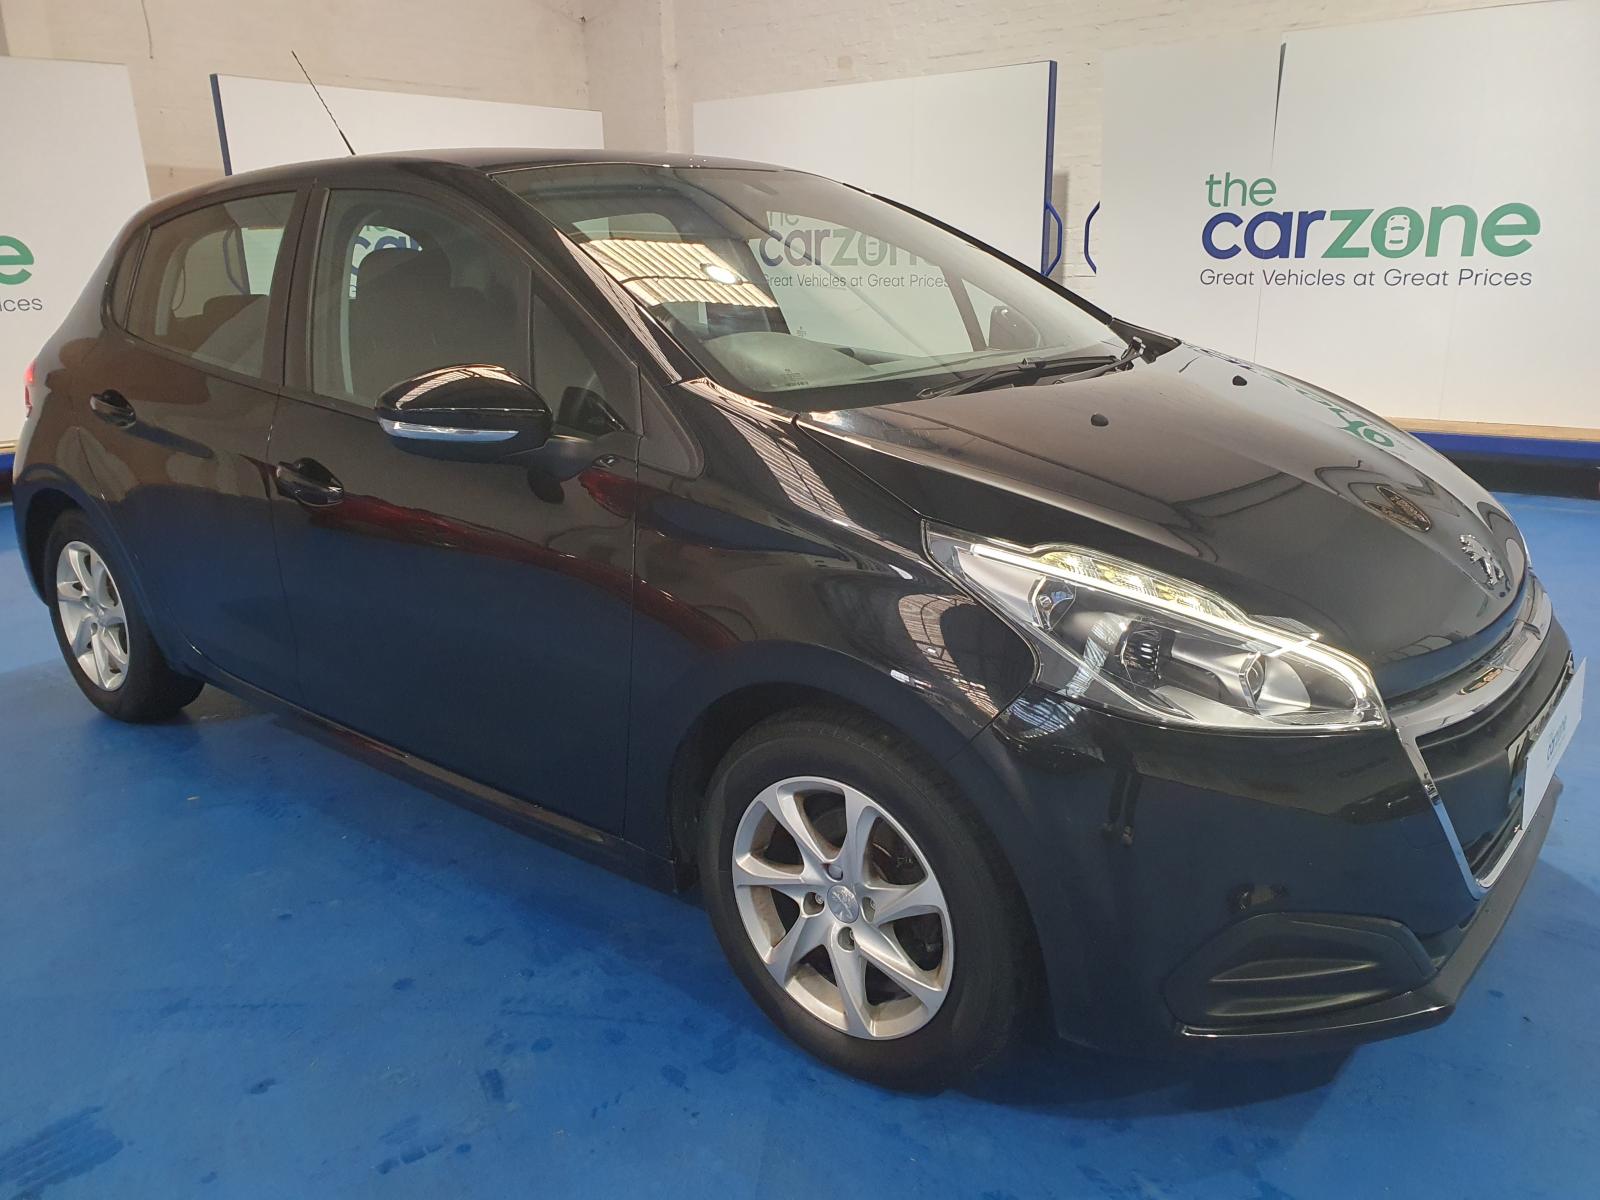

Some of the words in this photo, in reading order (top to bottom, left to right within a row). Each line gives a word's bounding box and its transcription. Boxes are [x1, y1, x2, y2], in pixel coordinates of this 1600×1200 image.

[1205, 172, 1277, 207] the
[1202, 202, 1541, 260] carzone
[765, 273, 793, 287] reat
[796, 272, 846, 288] Vehicles
[850, 275, 863, 287] at
[867, 273, 905, 288] Great
[1200, 268, 1255, 286] Great
[1262, 268, 1346, 287] Vehicles
[1353, 270, 1375, 287] at
[1384, 268, 1449, 287] Great
[1458, 268, 1533, 287] Prices
